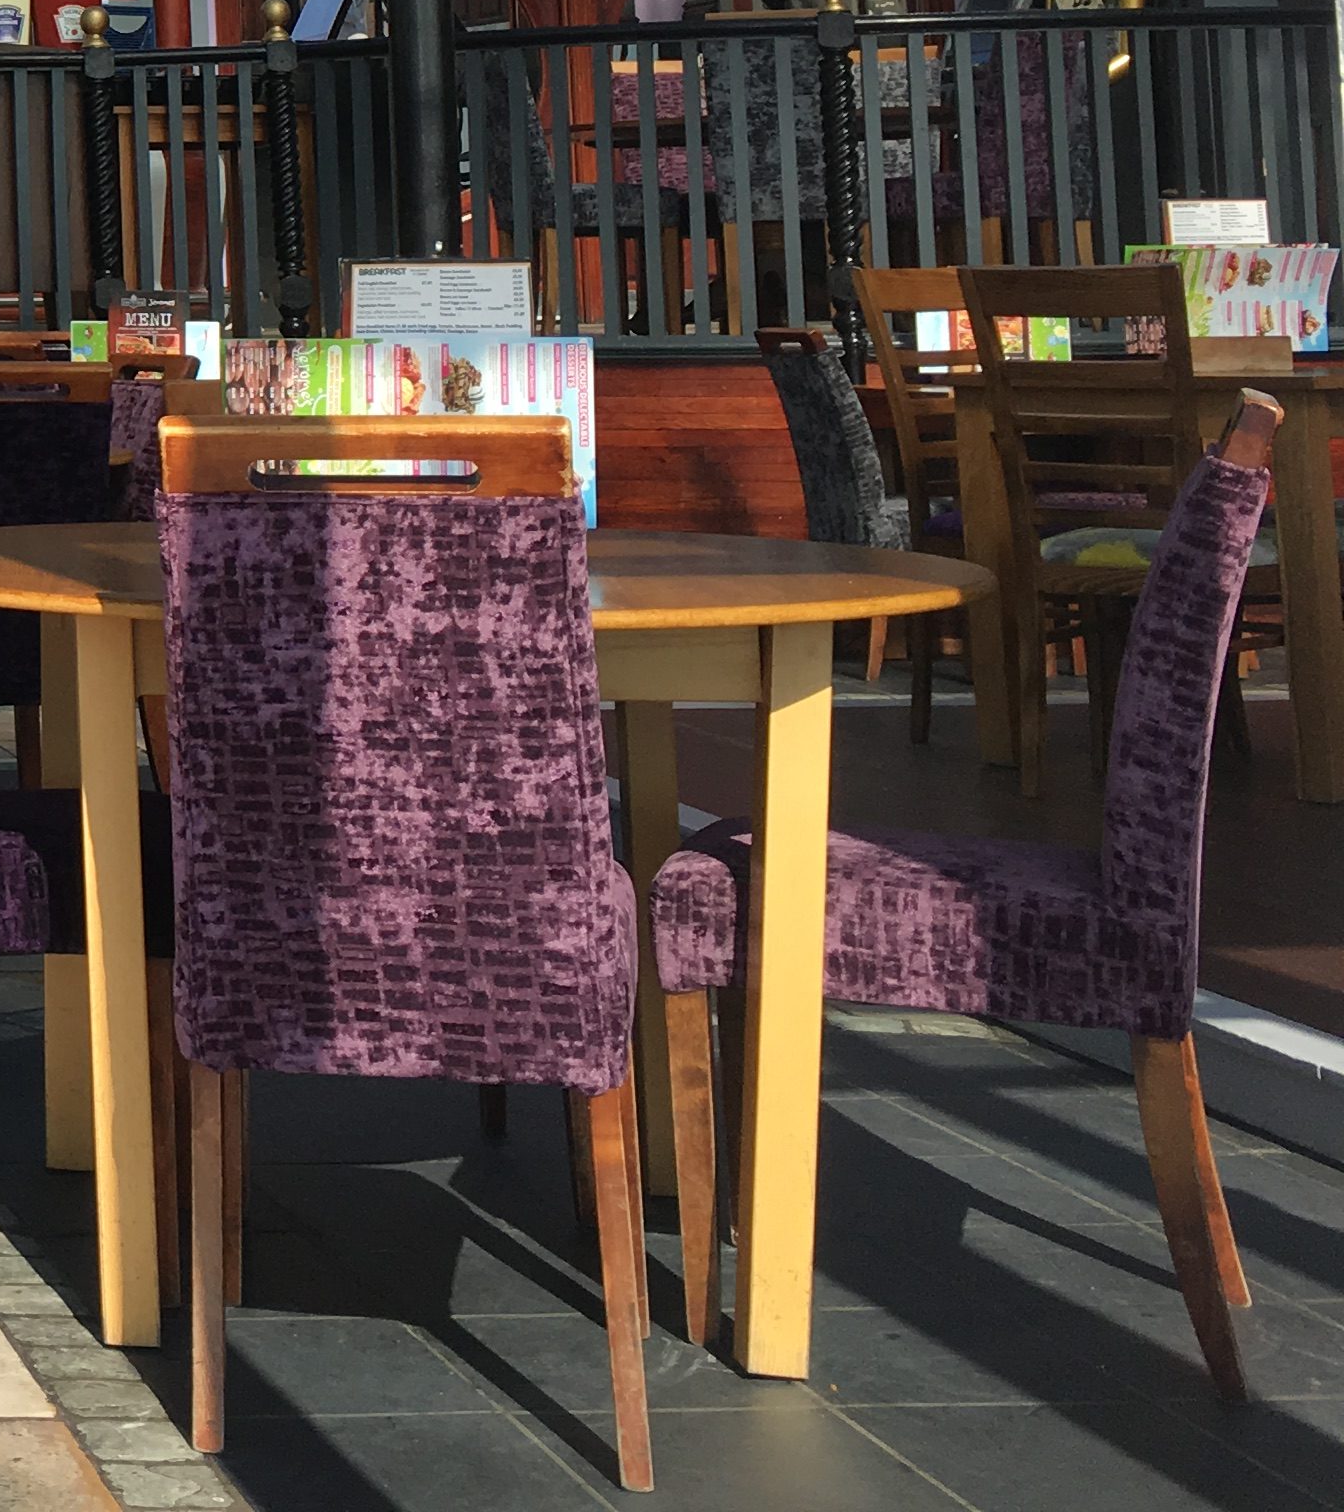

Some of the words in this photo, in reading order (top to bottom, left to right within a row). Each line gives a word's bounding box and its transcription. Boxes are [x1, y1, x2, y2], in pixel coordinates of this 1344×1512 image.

[358, 267, 407, 276] BREAKFAST
[125, 312, 172, 327] MENU
[292, 343, 317, 409] Jerome's
[567, 344, 576, 388] DESSERTS
[578, 344, 587, 392] DELICIOUS
[580, 392, 589, 447] DELECTABLE
